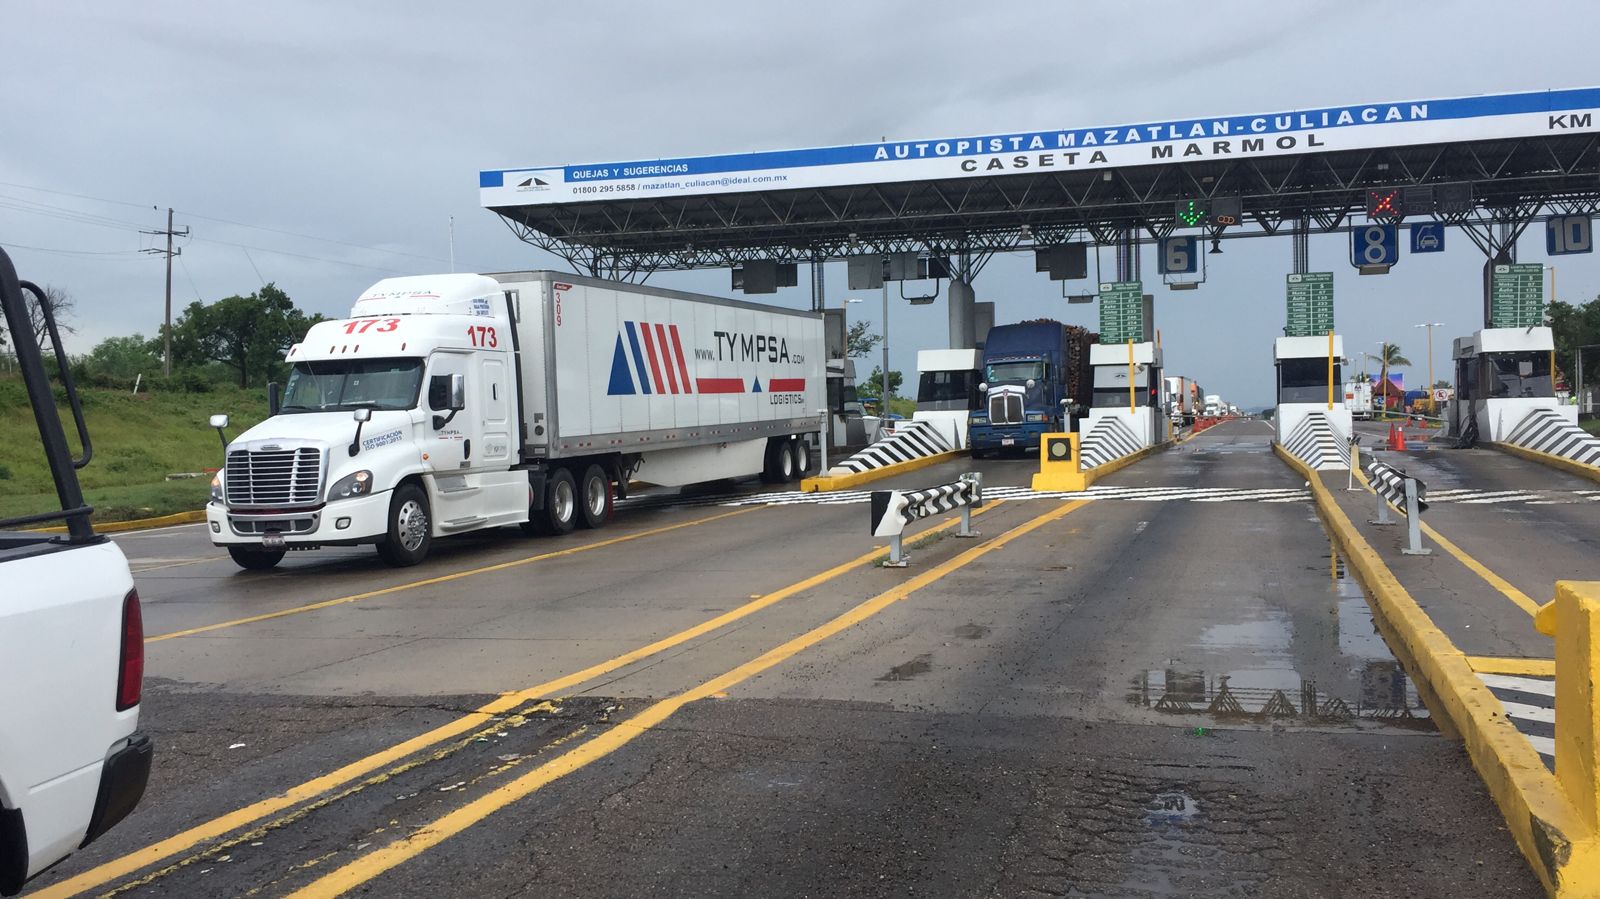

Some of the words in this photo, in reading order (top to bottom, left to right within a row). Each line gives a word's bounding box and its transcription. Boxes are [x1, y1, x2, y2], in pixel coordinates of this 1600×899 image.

[1549, 113, 1592, 129] KM
[874, 135, 1045, 160] AUTOPISTA
[1057, 104, 1428, 147] MAZATLAN-CULIACAN
[961, 150, 1108, 172] CASETA
[1151, 133, 1324, 159] MARMOL
[572, 169, 609, 179] QUEJAS
[613, 168, 620, 177] Y
[623, 163, 689, 176] SUGERENCIAS
[572, 186, 598, 195] 01800
[599, 185, 614, 193] 295
[616, 183, 636, 192] 5858
[642, 174, 788, 190] mazatlan_culiacan@ideal.com.mx
[1550, 216, 1590, 252] 10
[1166, 238, 1189, 271] 6
[1364, 226, 1387, 264] 8
[342, 318, 401, 335] 173
[467, 326, 497, 348] 173
[769, 394, 802, 405] LOGISTICS
[365, 443, 375, 451] ISO
